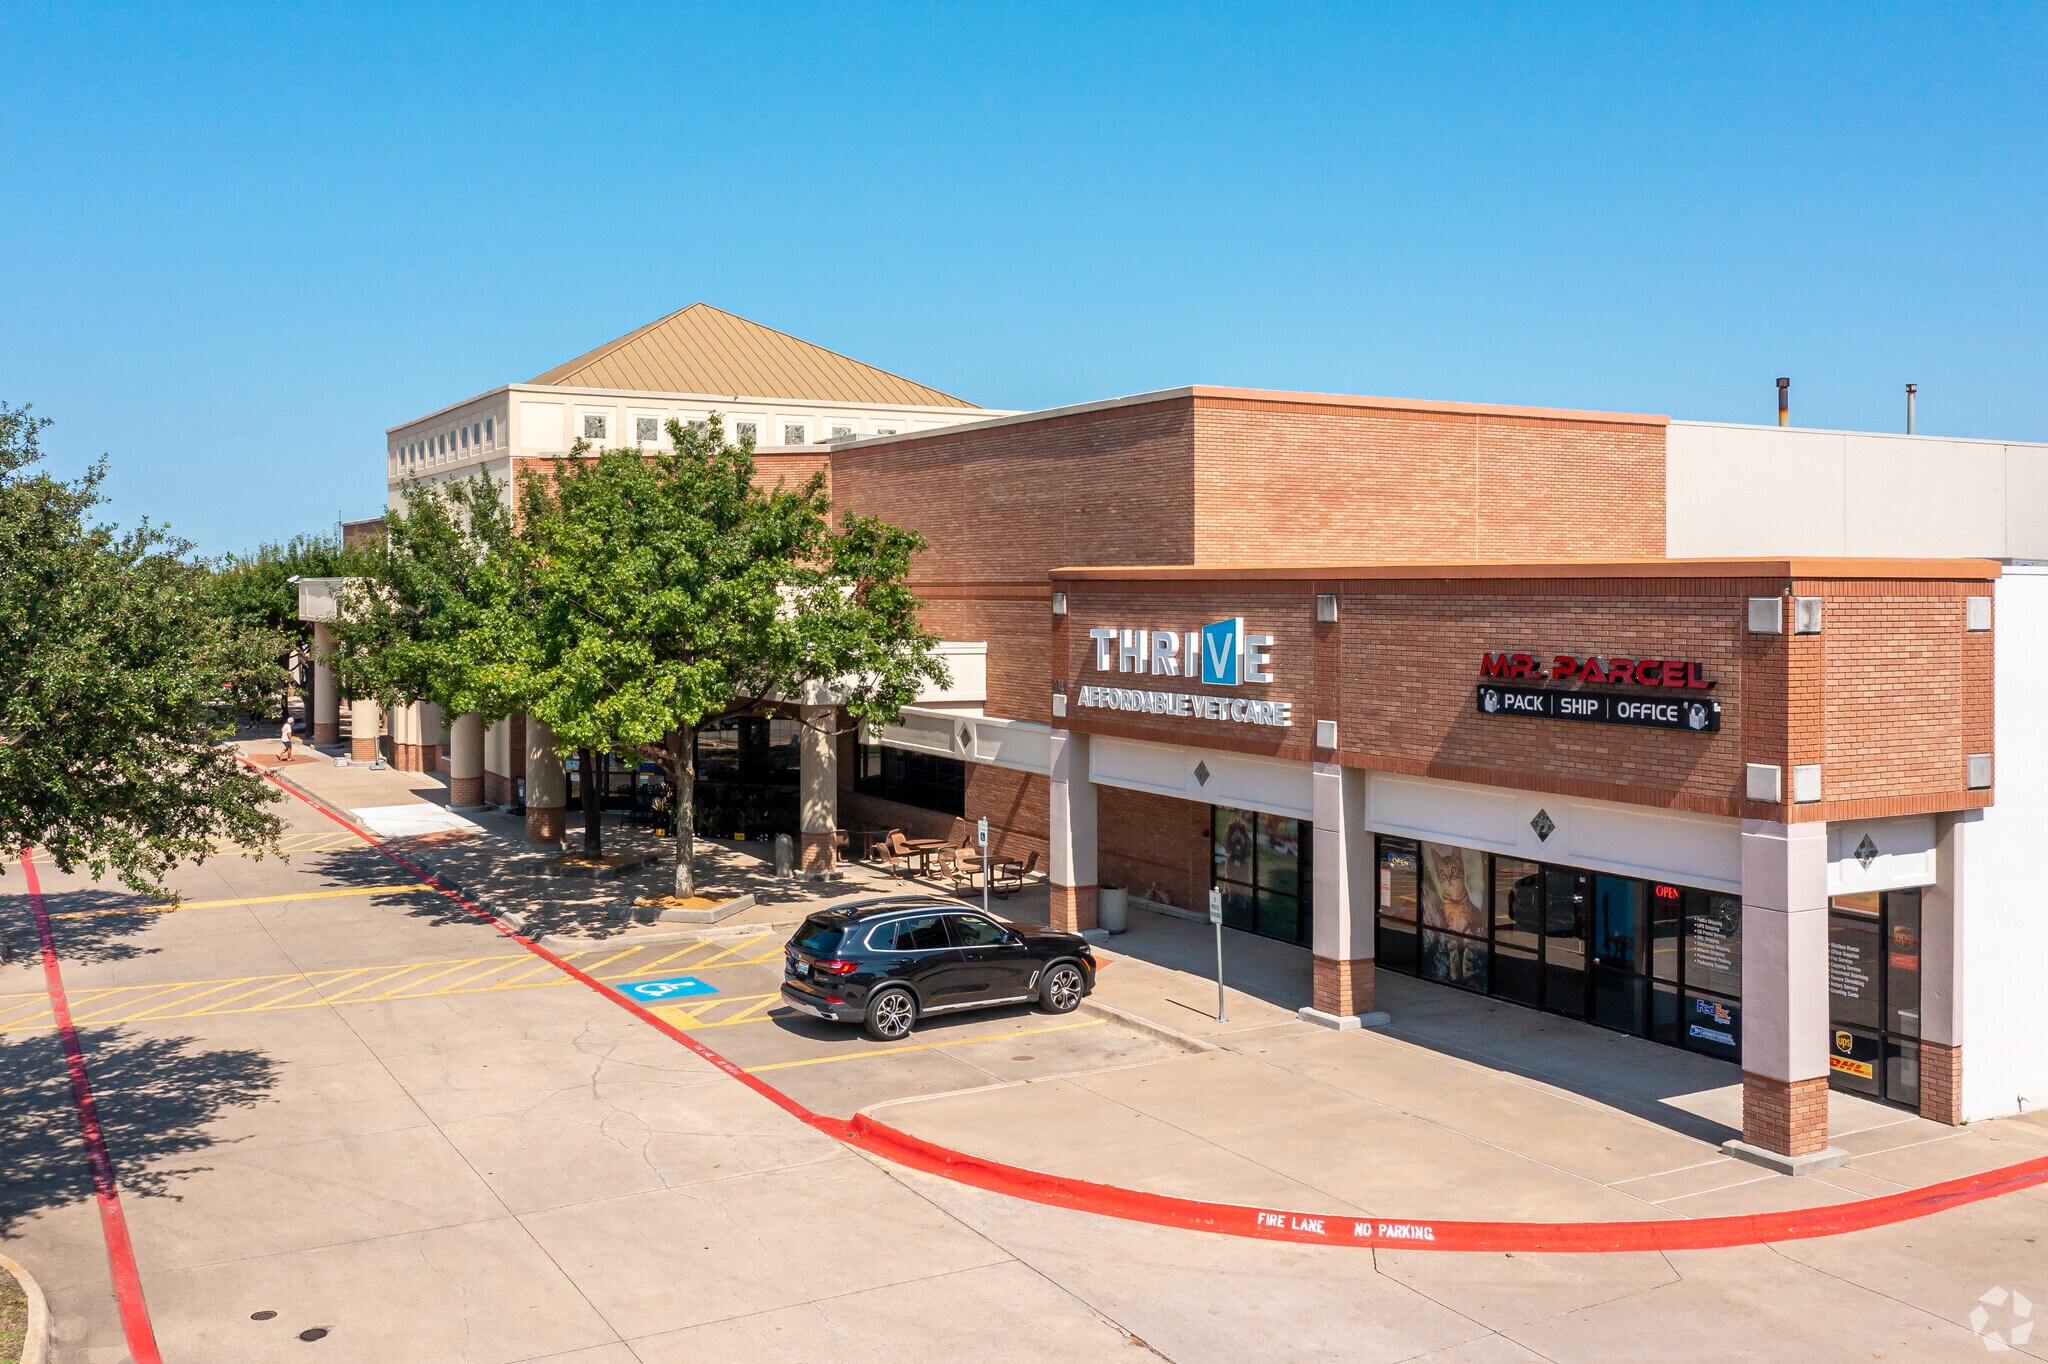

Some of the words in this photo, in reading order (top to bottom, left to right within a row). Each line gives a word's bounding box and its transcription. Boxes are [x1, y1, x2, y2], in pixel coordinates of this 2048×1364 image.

[1089, 627, 1274, 684] THRIVE
[1479, 651, 1548, 679] MR.
[1552, 655, 1717, 689] PARCEL
[1078, 685, 1189, 717] AFFORDABLE
[1191, 694, 1230, 721] VET
[1230, 698, 1293, 727] CARE
[1504, 693, 1544, 712] PACK
[1560, 697, 1599, 716] SHIP
[1617, 701, 1679, 723] OFFICE
[1391, 857, 1409, 866] OPEN
[1655, 884, 1679, 899] OPEN
[1697, 999, 1731, 1019] FedEx
[1838, 1037, 1852, 1049] ups
[1830, 1057, 1865, 1074] DHL
[1257, 1212, 1286, 1228] FIRE
[1291, 1216, 1326, 1235] LANE
[1354, 1222, 1373, 1236] NO
[1378, 1223, 1435, 1241] PARKING
